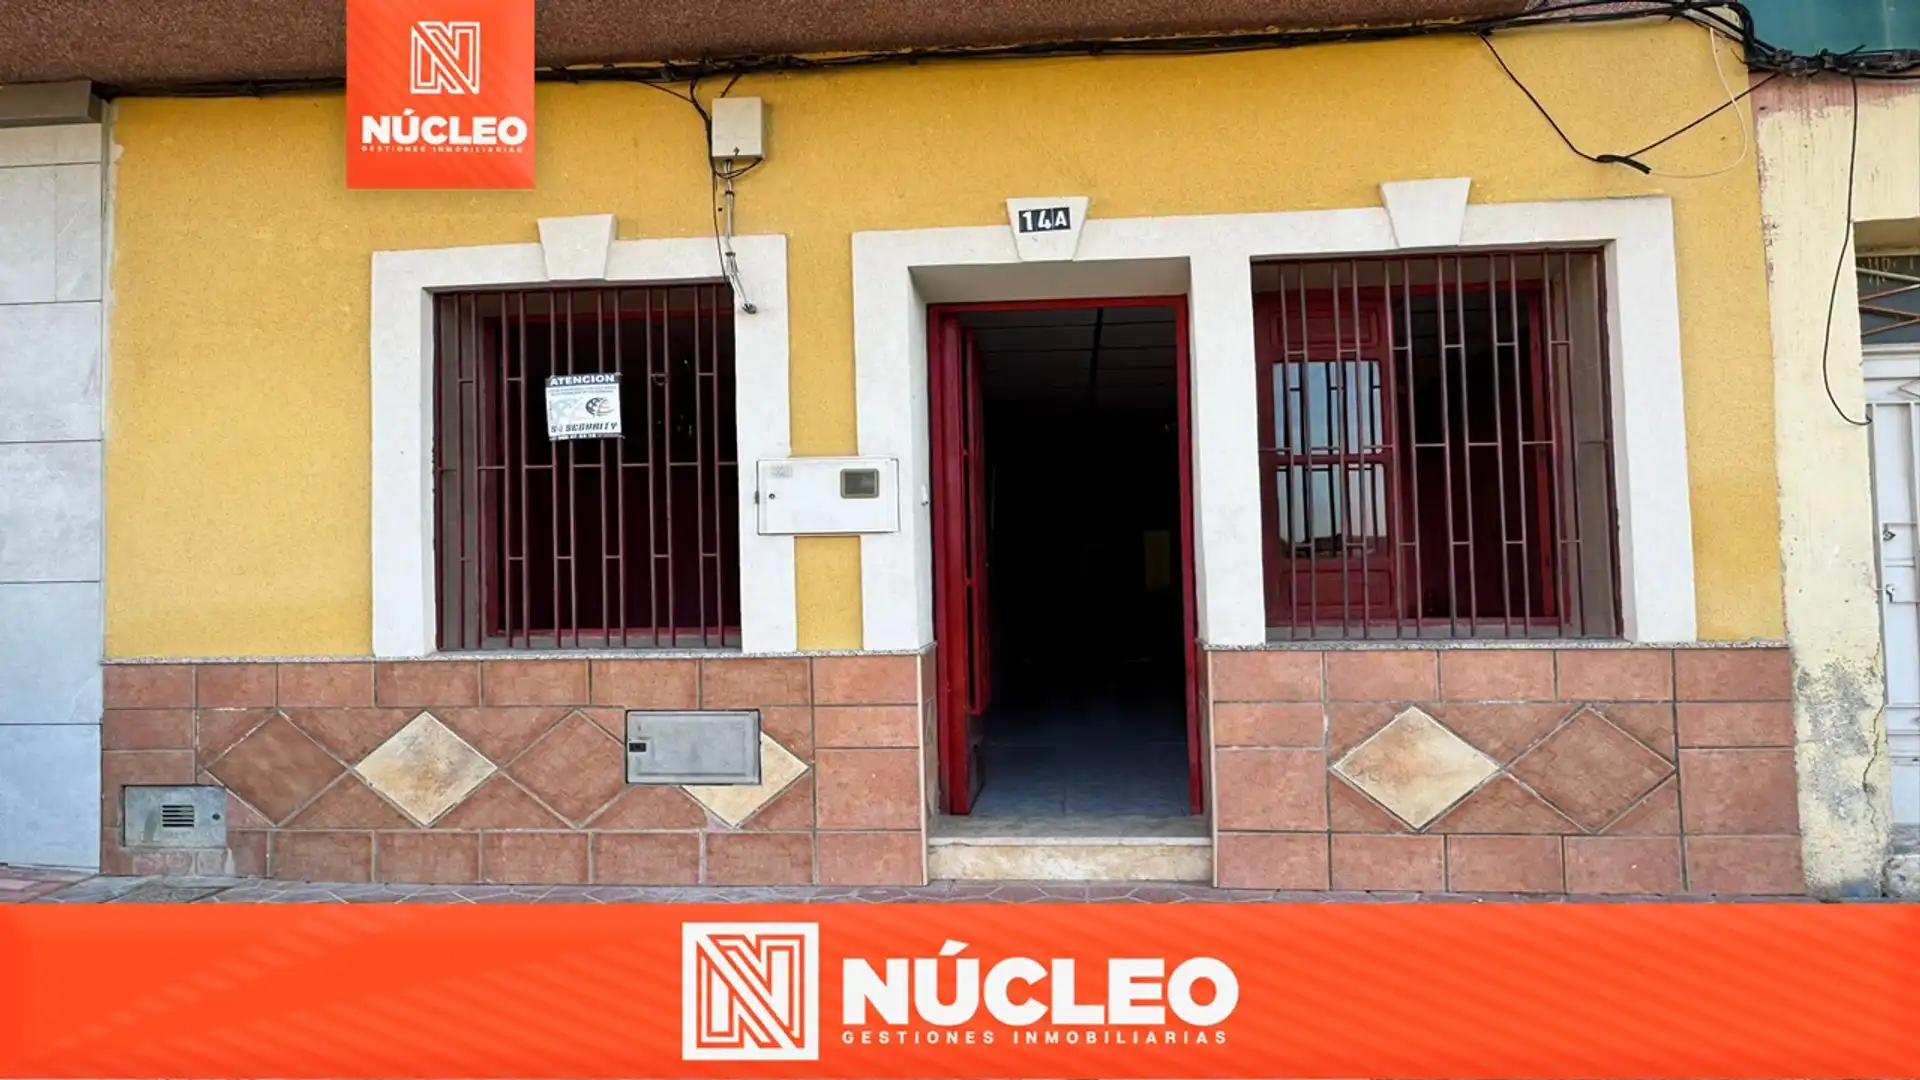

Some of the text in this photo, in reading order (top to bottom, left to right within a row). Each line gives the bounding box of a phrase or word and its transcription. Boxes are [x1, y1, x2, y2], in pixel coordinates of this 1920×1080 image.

[1022, 210, 1067, 231] 14A
[550, 374, 615, 386] ATENCION
[565, 422, 618, 432] SECURITY
